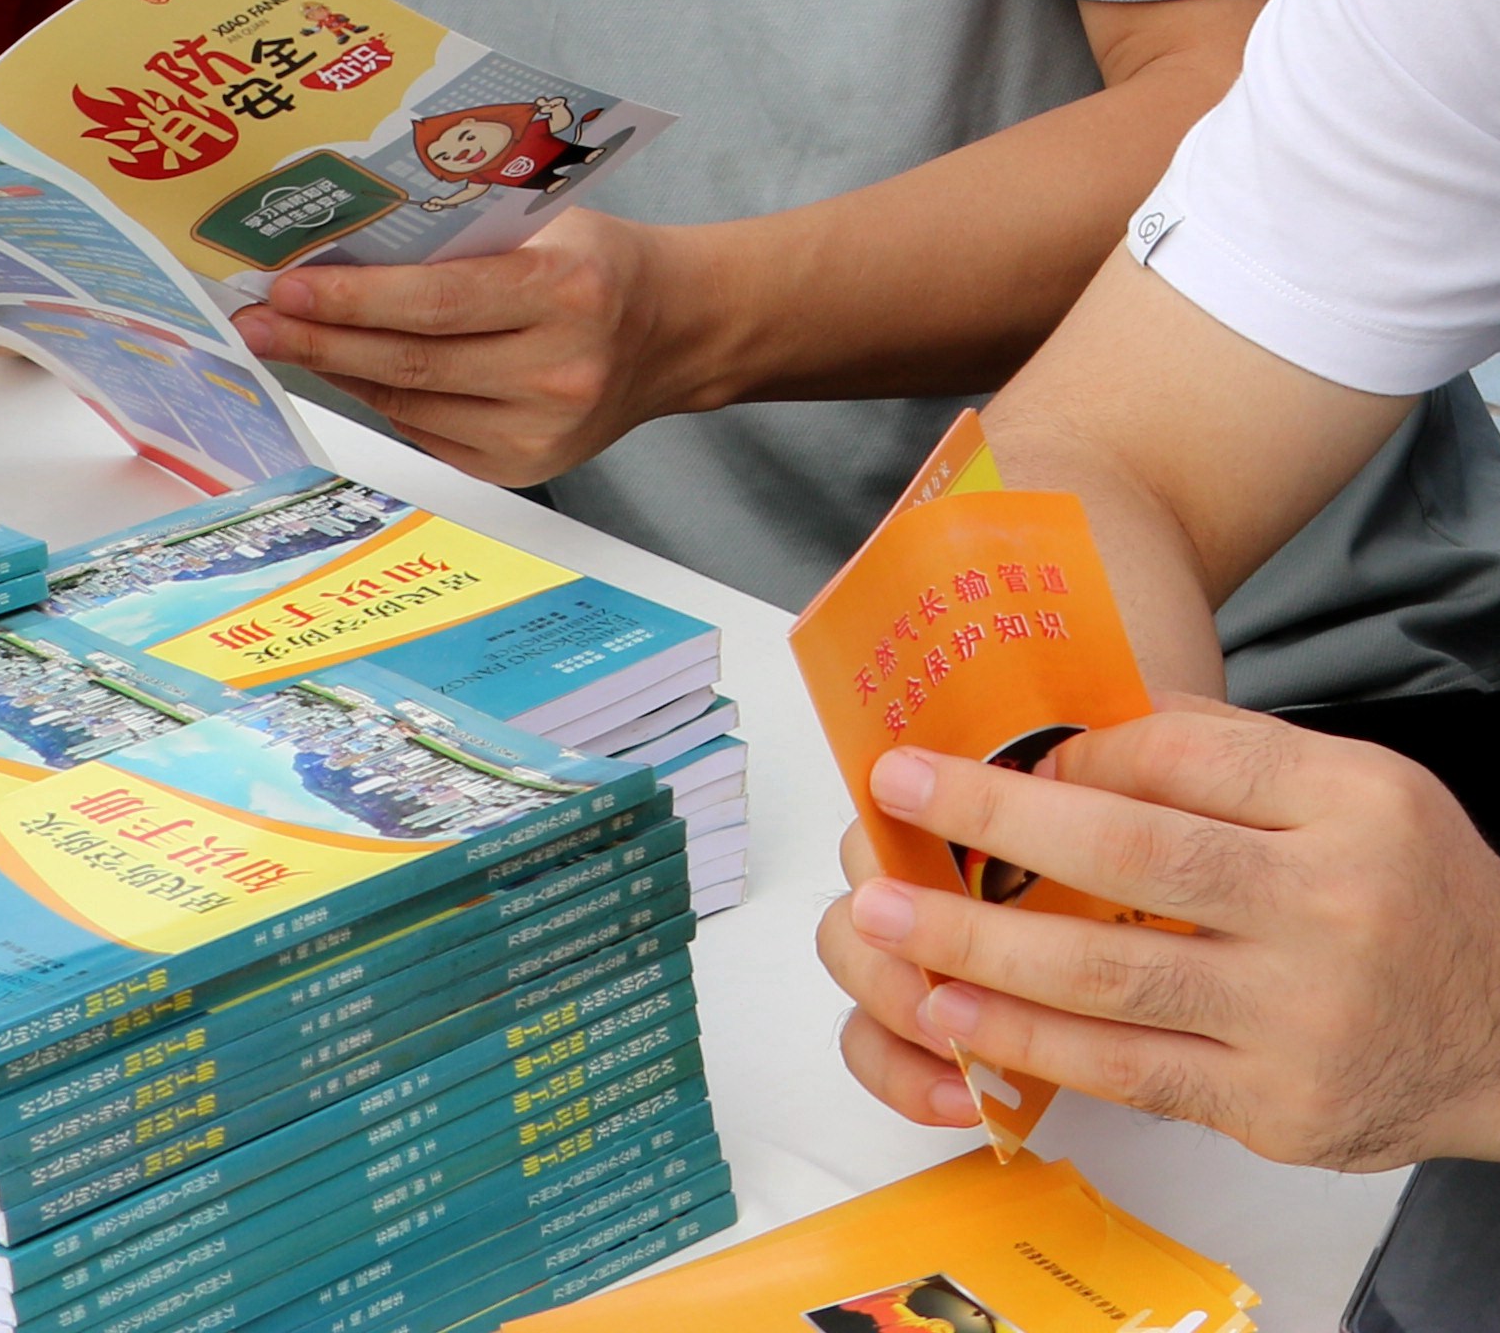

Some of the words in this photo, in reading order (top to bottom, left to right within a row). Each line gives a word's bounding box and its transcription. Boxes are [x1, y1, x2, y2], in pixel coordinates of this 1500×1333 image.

[210, 10, 250, 38] XIAO
[316, 42, 392, 90] 知识
[243, 176, 339, 232] 学习消防知识
[257, 184, 352, 240] 保障生命安全
[206, 550, 456, 651] 知识手册
[242, 568, 481, 666] 居民防空防灾
[853, 561, 1071, 707] 天然气长输管道
[883, 608, 1073, 742] 安全保护知识
[19, 810, 233, 916] 居民防空防灾
[68, 785, 313, 895] 知识手册
[84, 967, 169, 1019] 知识手册
[254, 929, 268, 948] 主
[579, 959, 672, 1024] 居民防空防灾
[18, 1059, 122, 1120] 居民防空防灾
[123, 1025, 207, 1078] 知识手册
[506, 1001, 579, 1051] 知识手册
[40, 1162, 143, 1224] 居民防空防灾
[143, 1125, 227, 1181] 知识手册
